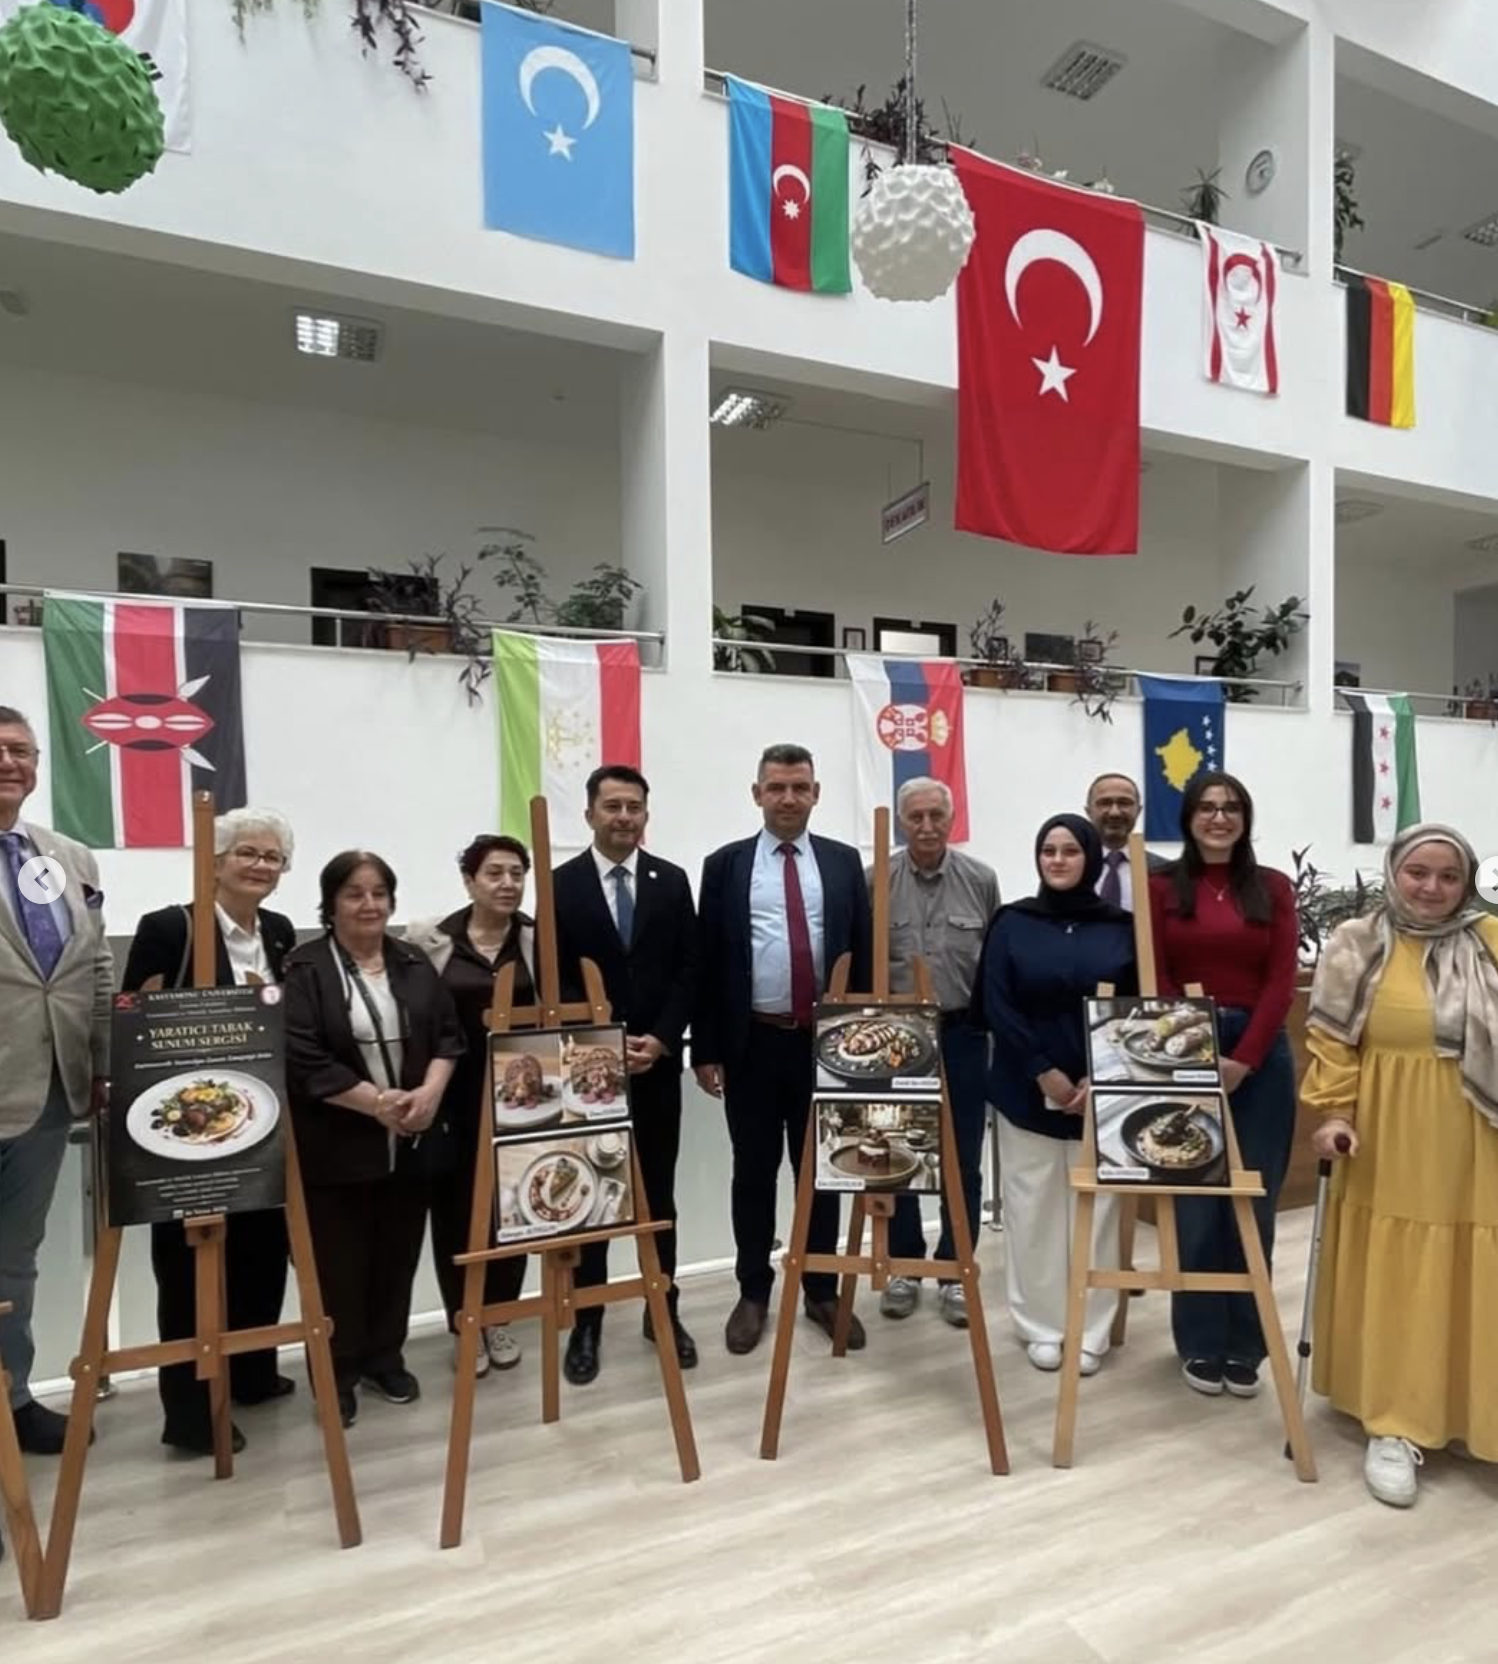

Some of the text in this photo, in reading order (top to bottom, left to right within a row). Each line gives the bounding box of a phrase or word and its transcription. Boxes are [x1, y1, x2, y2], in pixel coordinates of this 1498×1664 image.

[149, 1021, 253, 1039] YARATICI TABAK
[151, 1037, 195, 1049] SUNUM
